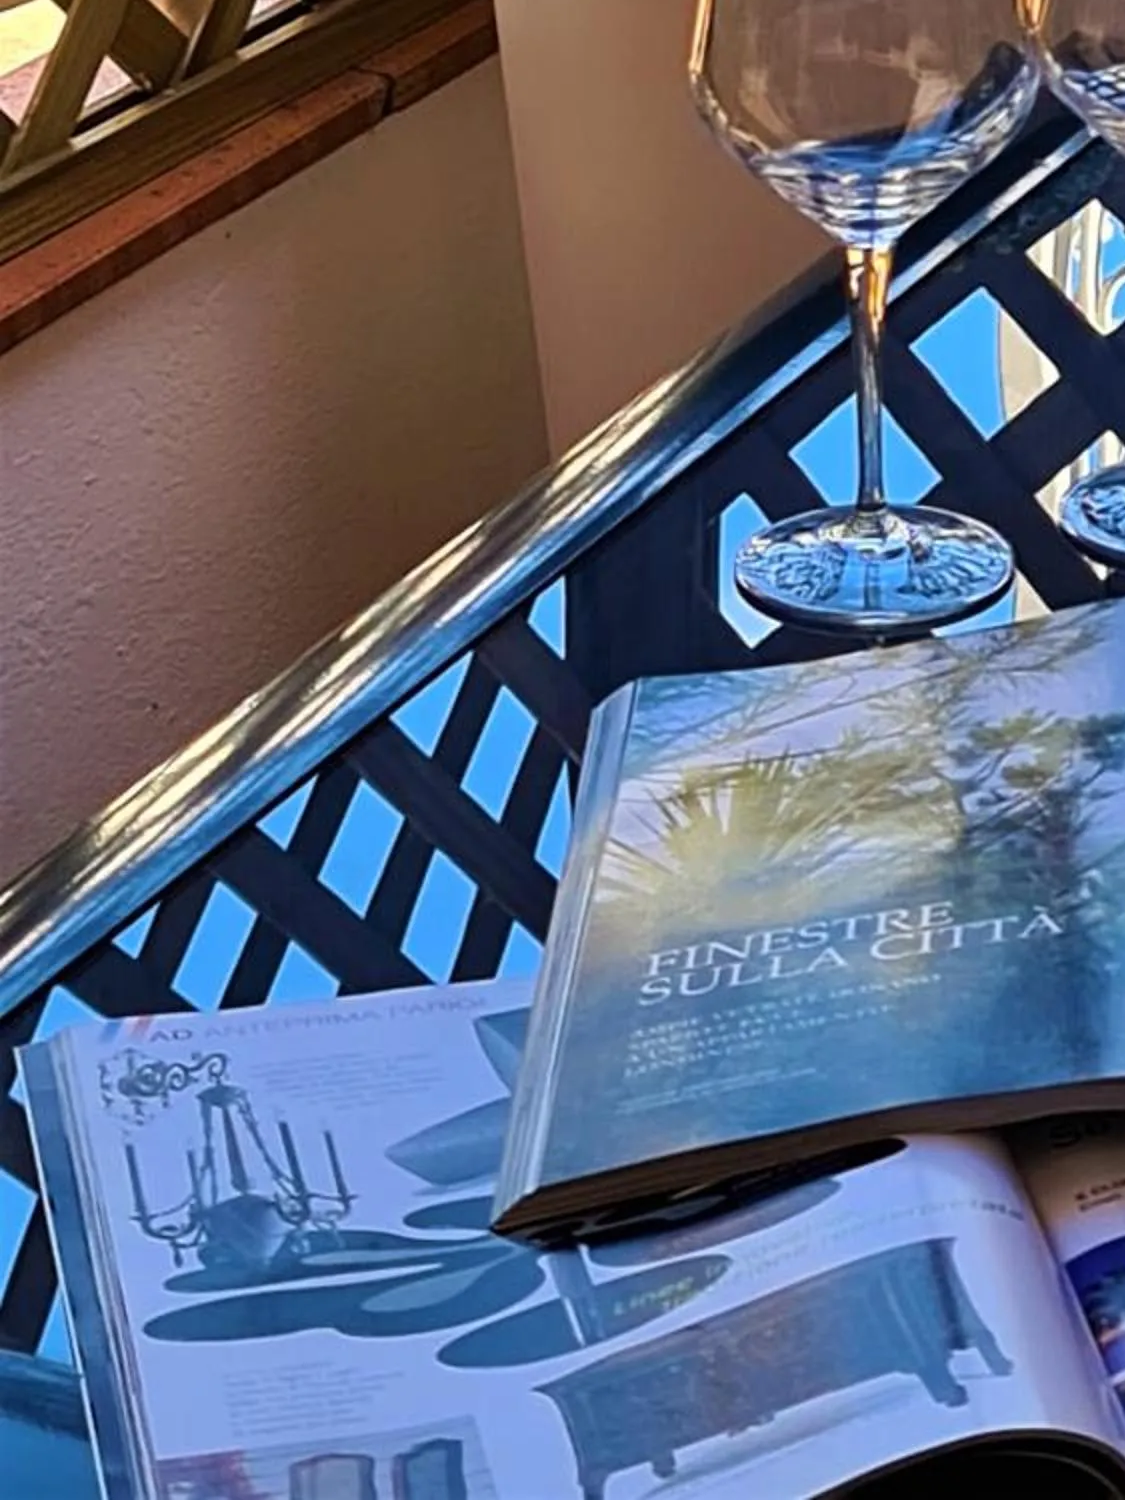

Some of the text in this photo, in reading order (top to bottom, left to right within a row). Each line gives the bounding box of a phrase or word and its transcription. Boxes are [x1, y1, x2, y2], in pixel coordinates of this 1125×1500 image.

[638, 905, 1064, 1007] SULLA CITTÀ
[645, 901, 956, 977] FINESTRE
[150, 1027, 193, 1043] AD
